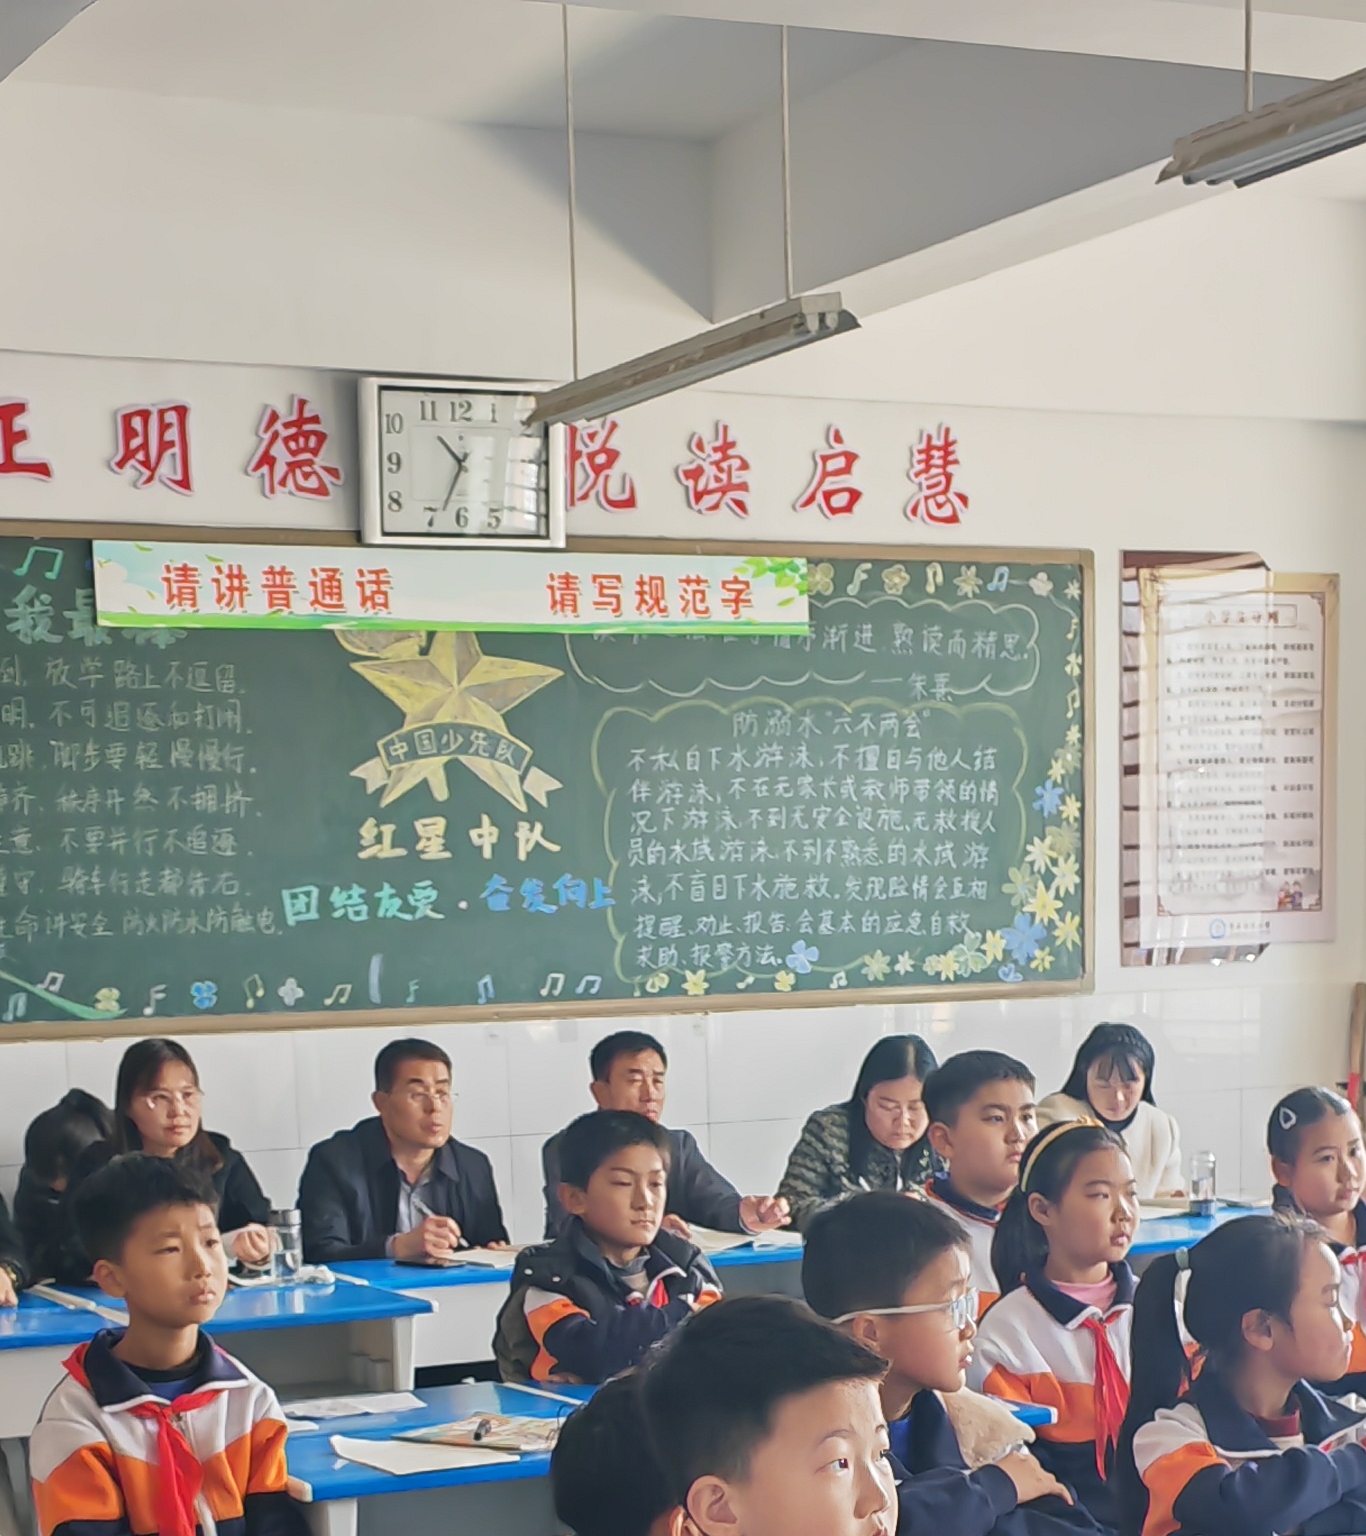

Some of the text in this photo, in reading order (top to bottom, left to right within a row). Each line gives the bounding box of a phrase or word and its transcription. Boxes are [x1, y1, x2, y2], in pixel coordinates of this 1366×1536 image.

[419, 400, 438, 422] 11
[449, 400, 473, 422] 12
[385, 413, 403, 434] 10
[386, 452, 402, 474] 9
[565, 418, 971, 528] 悦读启慧
[387, 491, 402, 512] 8
[423, 506, 438, 528] 7
[455, 506, 469, 528] 6
[487, 508, 502, 528] 5
[161, 563, 755, 621] 请讲普通话 请写规范字
[388, 728, 516, 766] 中国少先队
[357, 813, 562, 862] 红星中队
